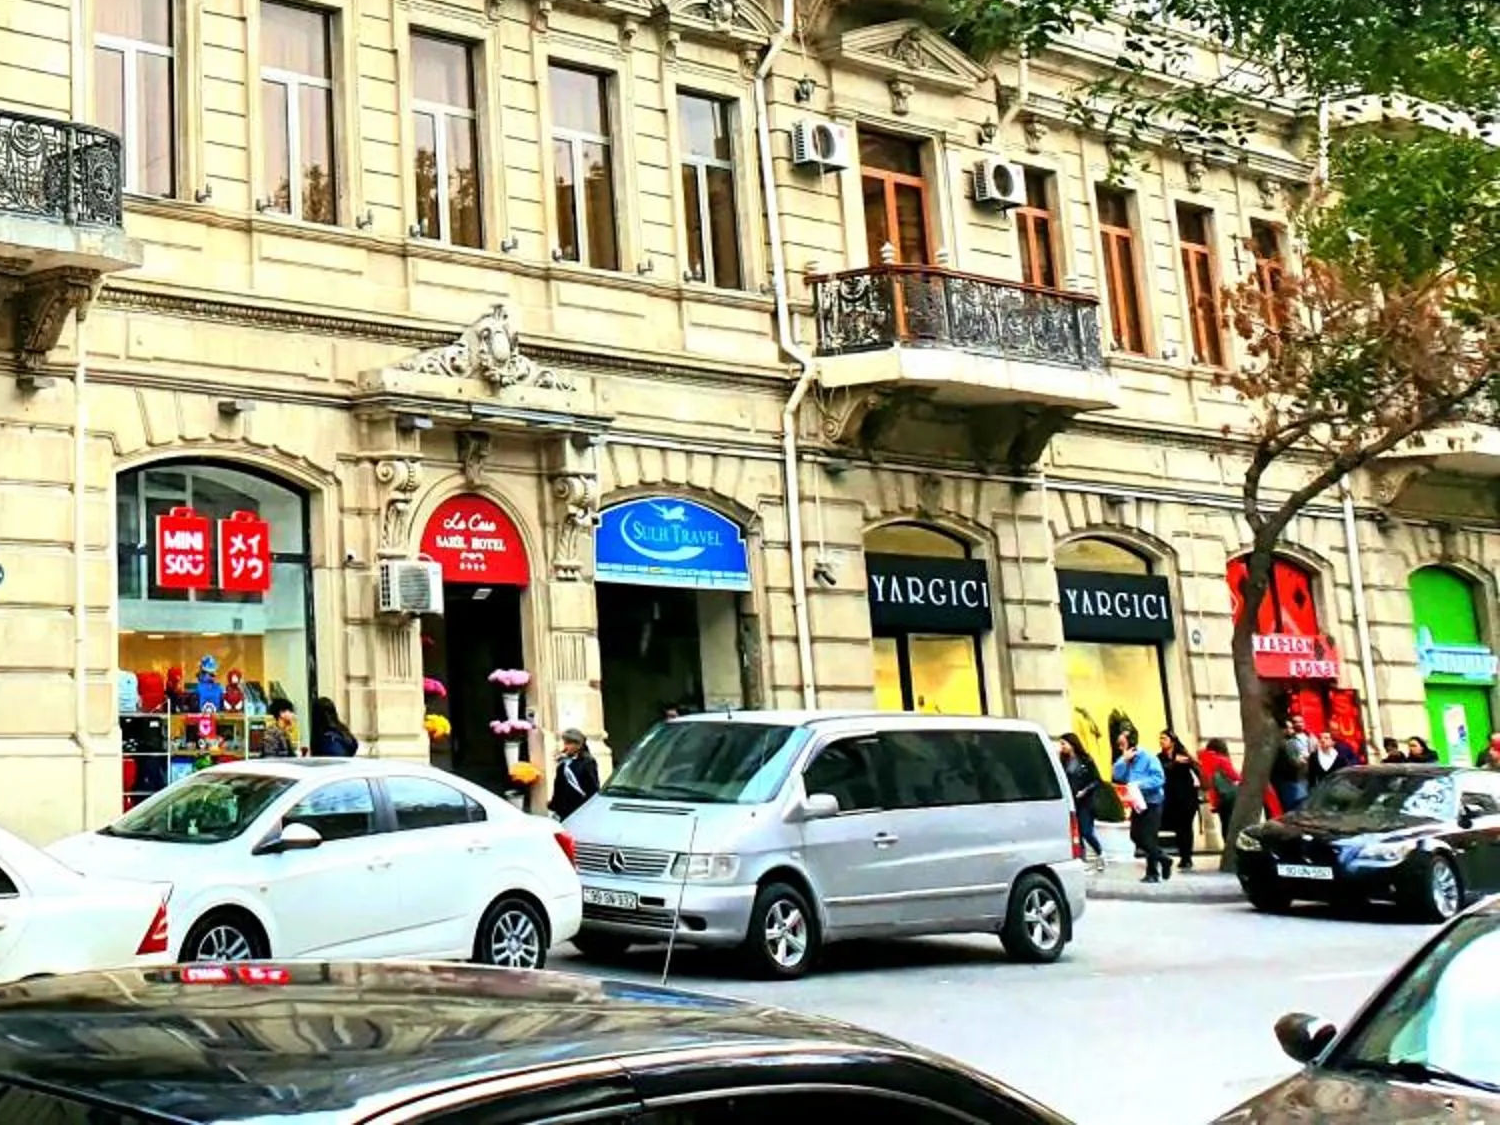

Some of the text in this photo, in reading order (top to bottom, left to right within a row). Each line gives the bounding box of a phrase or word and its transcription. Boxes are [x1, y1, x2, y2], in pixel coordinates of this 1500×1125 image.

[443, 511, 466, 531] La
[163, 530, 203, 551] MINI
[229, 533, 261, 555] メイ
[471, 537, 507, 552] HOTEL
[230, 558, 263, 579] ソウ
[870, 573, 989, 609] YARGICI
[1065, 588, 1169, 621] YARGICI
